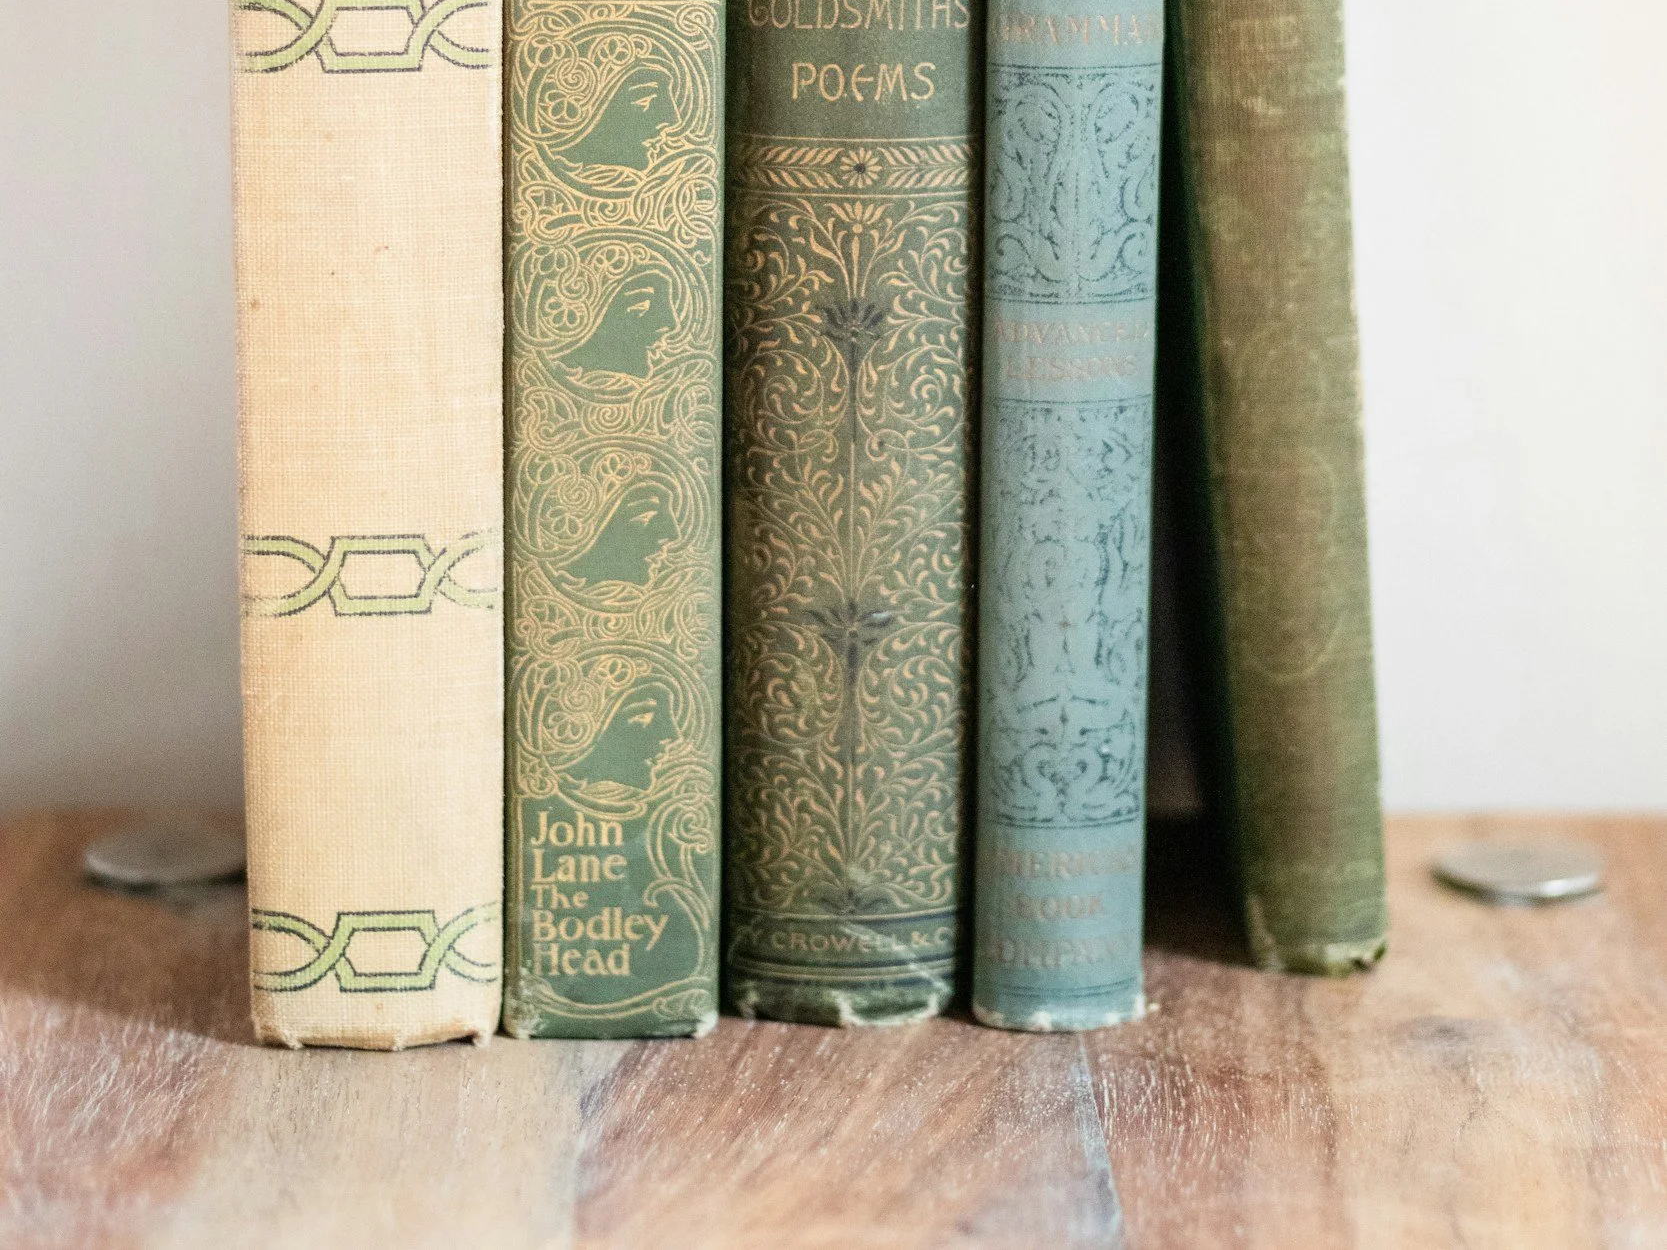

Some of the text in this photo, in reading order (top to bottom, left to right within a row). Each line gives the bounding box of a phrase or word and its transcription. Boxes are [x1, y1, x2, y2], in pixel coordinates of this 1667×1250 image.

[791, 62, 937, 102] POEMS
[530, 810, 624, 847] John
[531, 848, 628, 883] Lane
[530, 884, 590, 910] The
[532, 907, 669, 951] Bodley
[771, 931, 908, 952] CROWELL
[533, 943, 631, 977] Head
